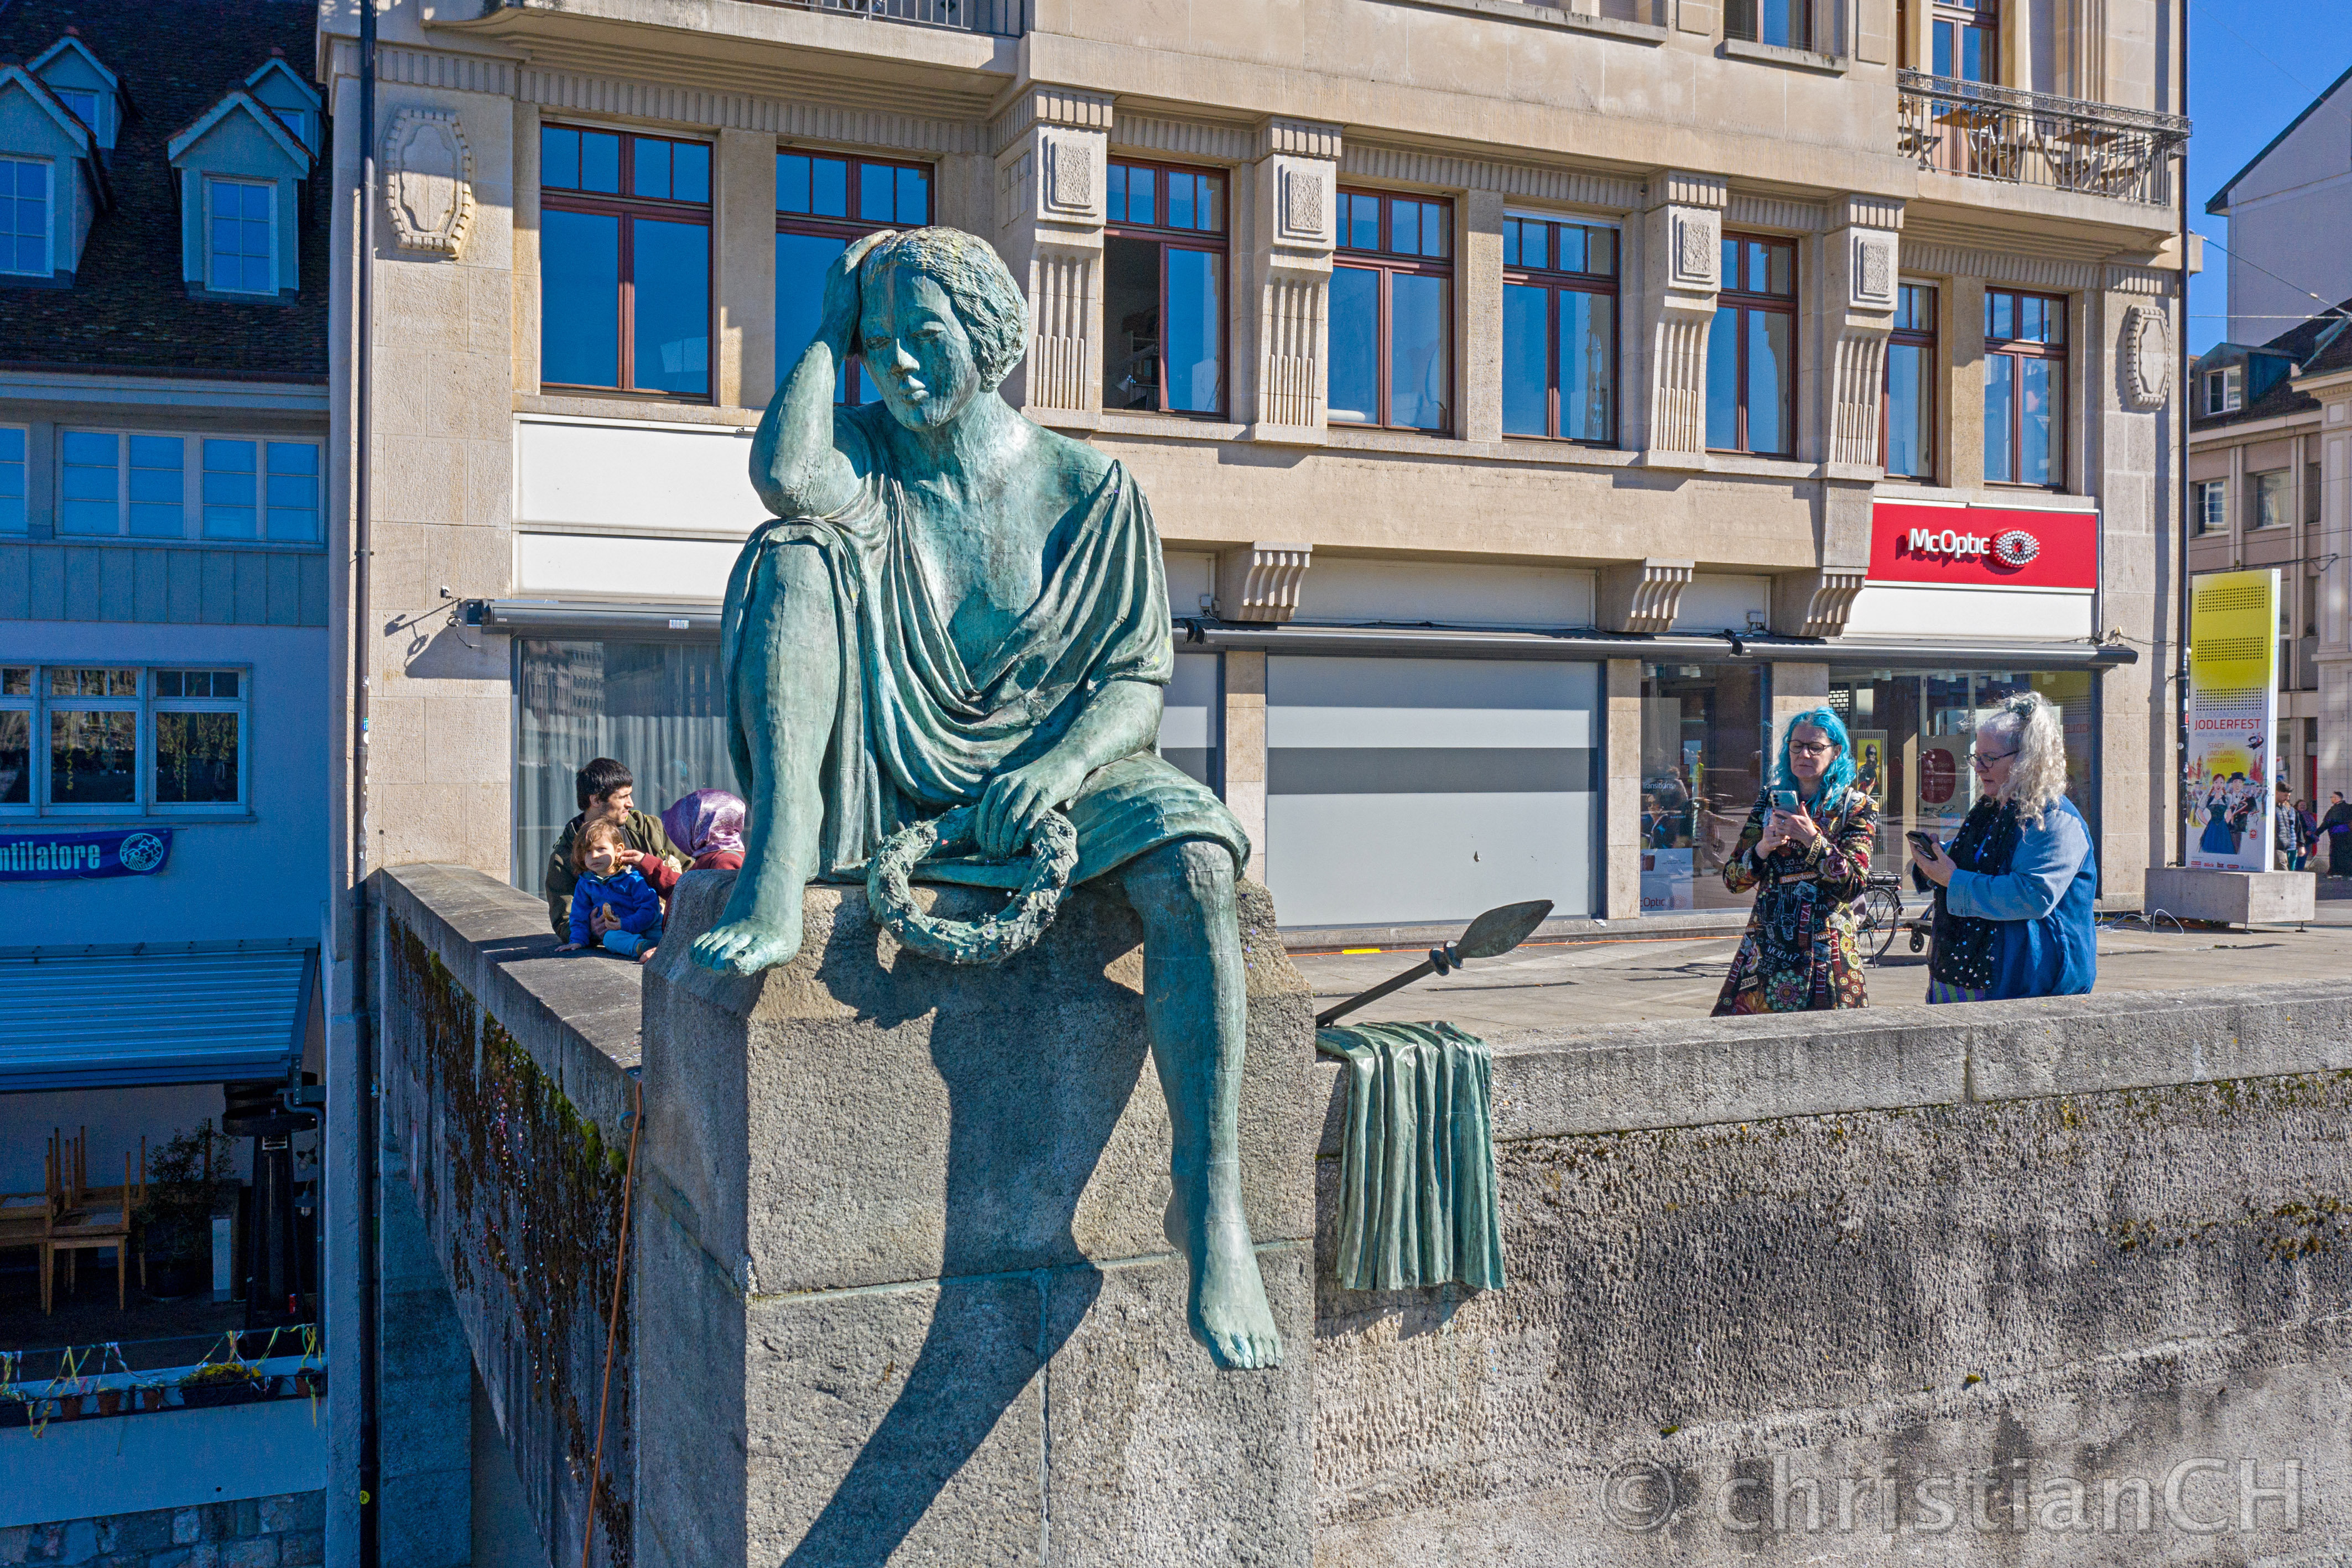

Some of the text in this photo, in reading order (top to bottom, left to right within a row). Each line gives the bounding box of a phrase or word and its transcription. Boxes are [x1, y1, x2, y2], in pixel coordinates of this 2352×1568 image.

[1909, 528, 1990, 558] McOptic
[2195, 719, 2261, 730] JODLERFEST
[1642, 781, 1675, 790] Transitions
[0, 841, 100, 871] ntilatore
[1782, 872, 1817, 883] Barcelona
